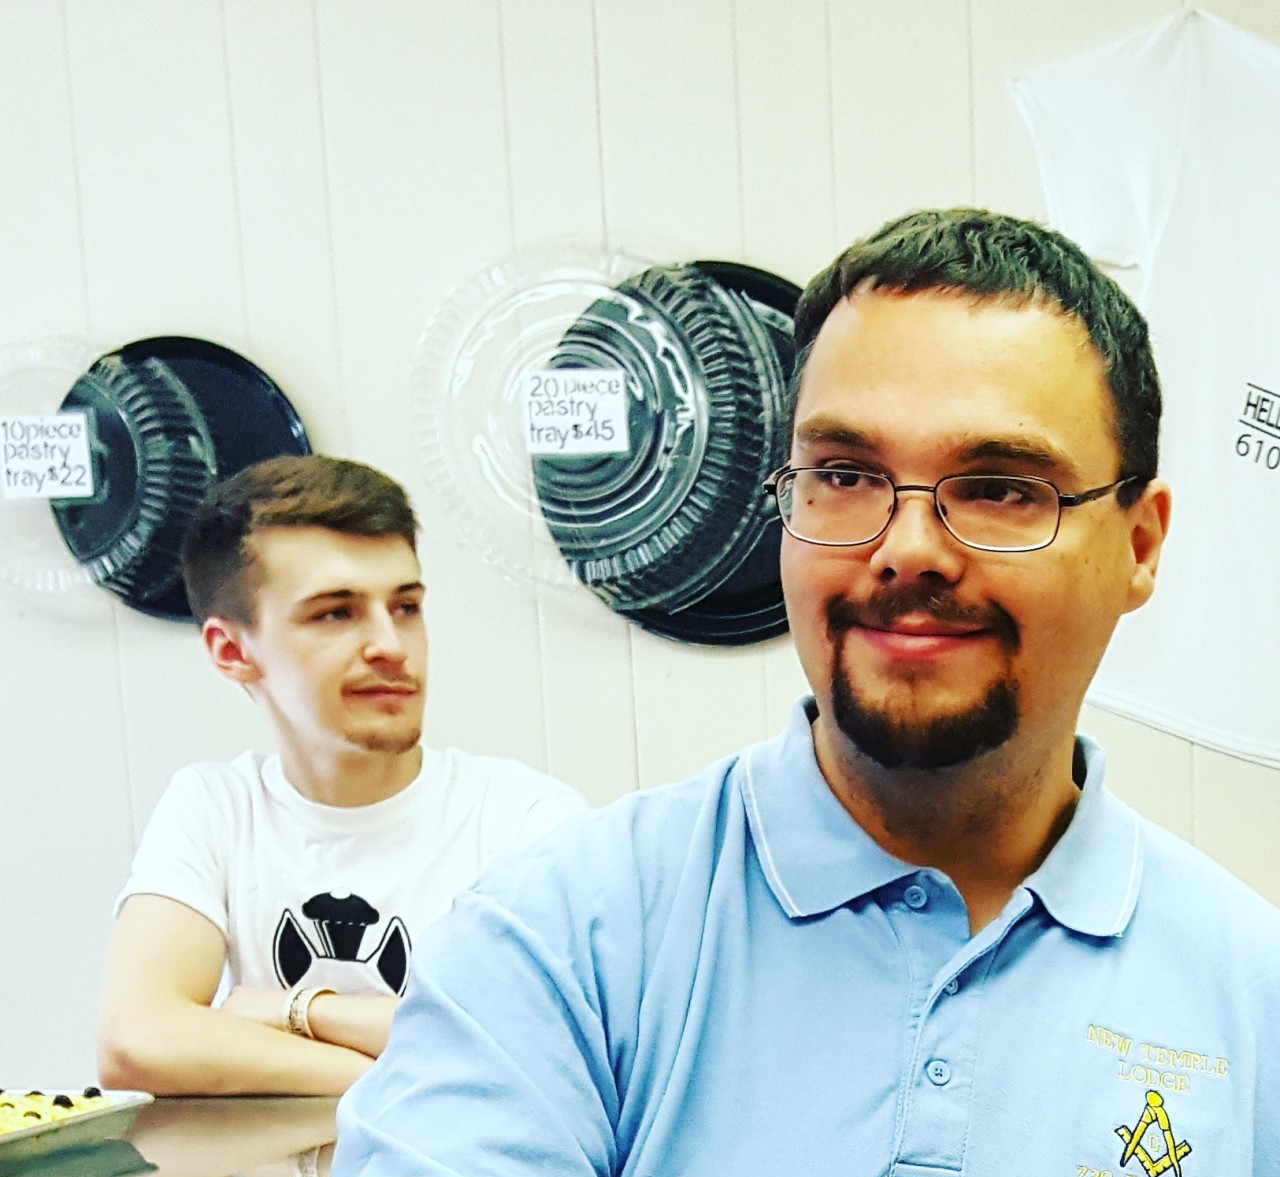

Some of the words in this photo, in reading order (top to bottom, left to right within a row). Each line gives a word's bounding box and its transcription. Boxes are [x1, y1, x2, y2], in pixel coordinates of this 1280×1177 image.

[529, 375, 559, 398] 20
[528, 396, 598, 421] pastry
[529, 422, 570, 450] tray
[571, 419, 615, 441] $45
[4, 441, 70, 466] pastry
[6, 468, 46, 494] tray
[48, 465, 87, 487] $22
[1087, 1023, 1133, 1056] NEW
[1138, 1042, 1230, 1078] TEMPLE
[1118, 1059, 1191, 1095] LODGE
